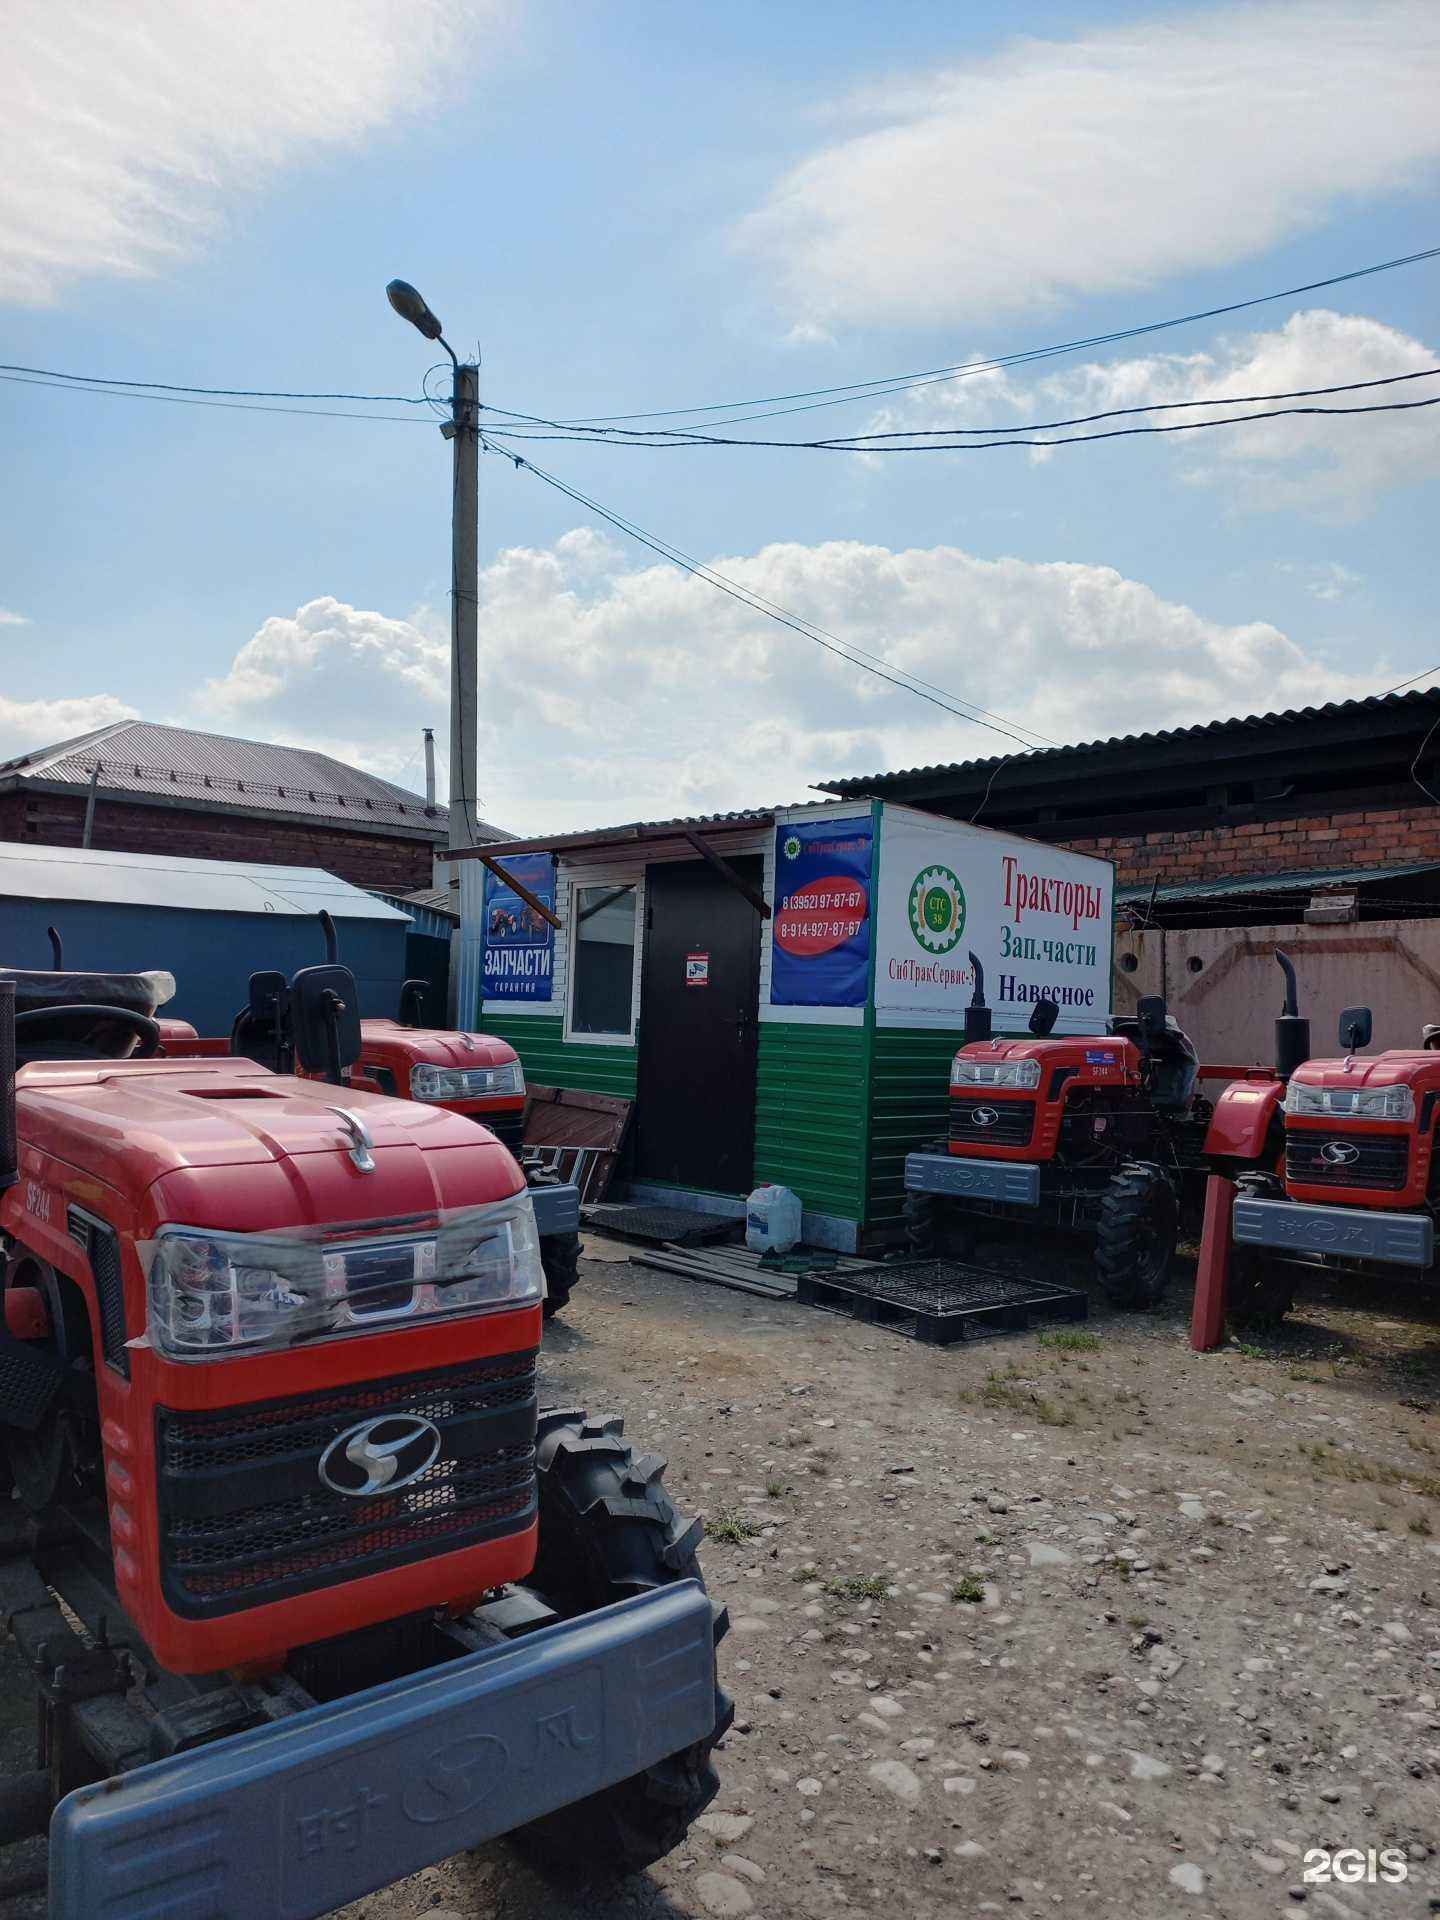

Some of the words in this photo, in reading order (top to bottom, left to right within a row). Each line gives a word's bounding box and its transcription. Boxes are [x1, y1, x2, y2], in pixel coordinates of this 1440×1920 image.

[782, 896, 789, 910] 8
[819, 892, 861, 909] 97-87-67
[1002, 855, 1102, 931] Тракторы
[781, 921, 861, 938] 8-914-927-87-67
[999, 925, 1097, 966] Зап.части
[484, 949, 551, 976] ЗАПЧАСТИ
[888, 958, 977, 990] СибТракСервис-3
[998, 974, 1095, 1007] Навесное
[27, 1182, 50, 1223] SF244
